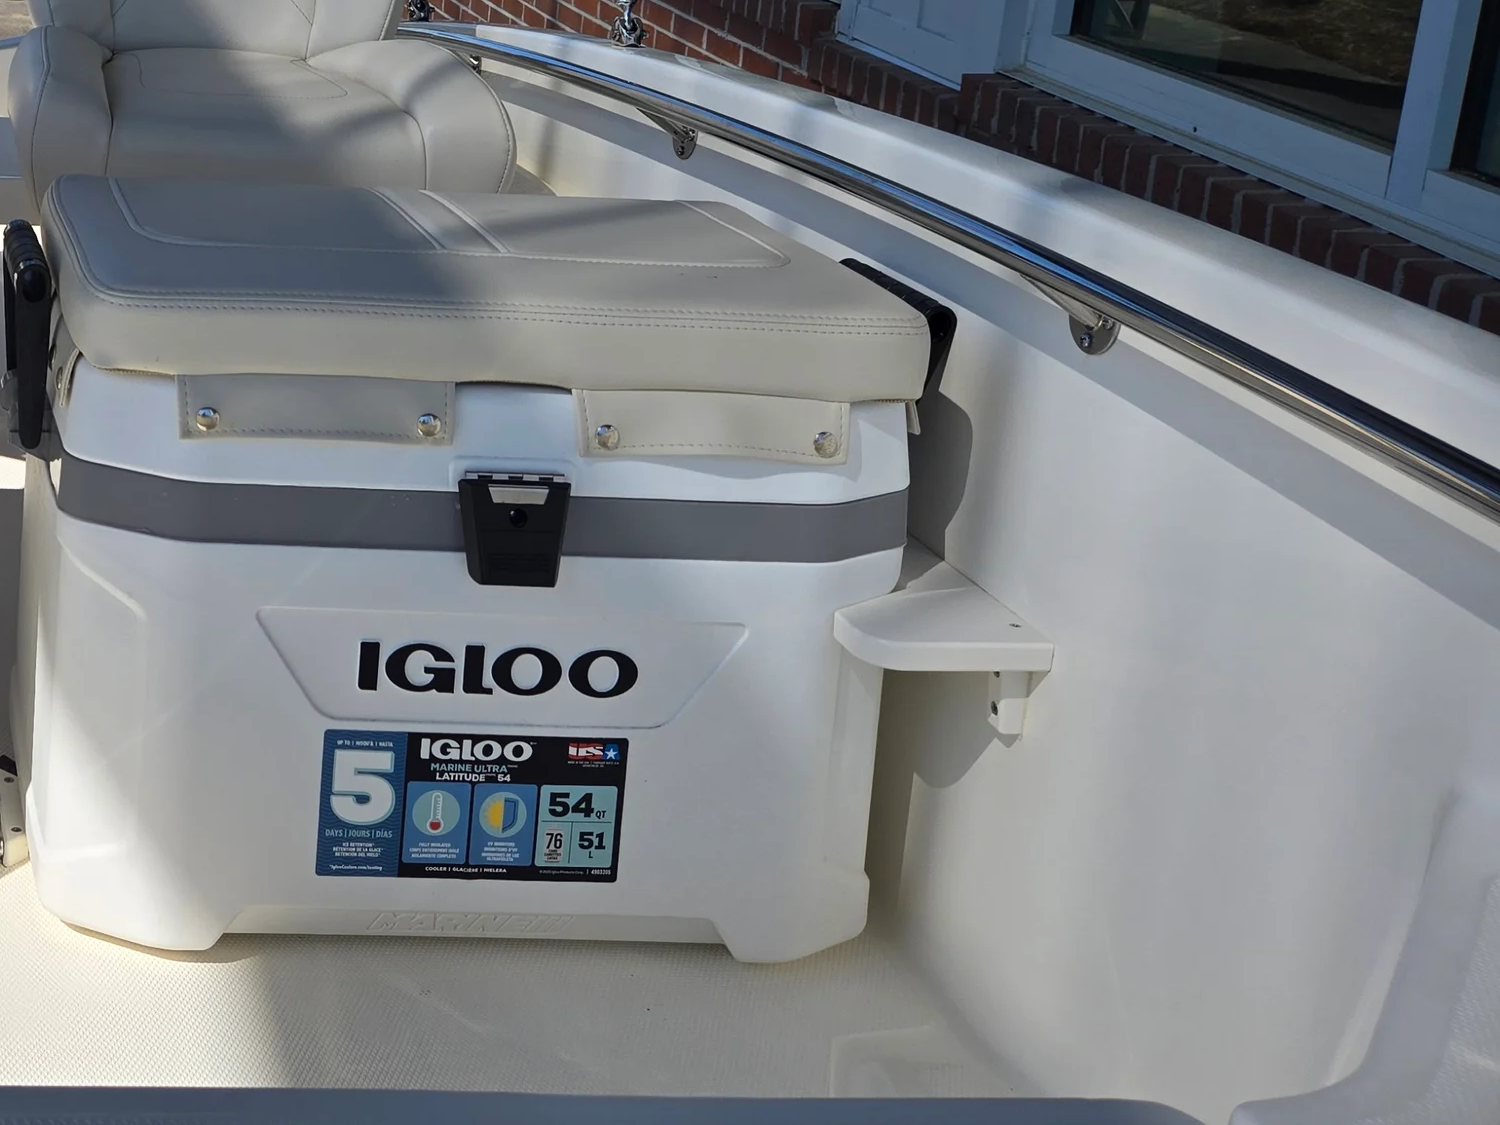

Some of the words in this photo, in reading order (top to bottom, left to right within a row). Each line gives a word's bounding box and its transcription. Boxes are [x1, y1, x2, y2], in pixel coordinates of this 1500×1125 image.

[357, 640, 639, 699] IGLOO
[419, 737, 533, 762] IGLOO
[430, 763, 473, 772] MARINE
[474, 764, 508, 773] ULTRA
[435, 772, 486, 782] LATITUDE
[497, 774, 511, 783] 54
[329, 748, 396, 826] 5
[548, 791, 595, 818] 54
[595, 810, 607, 820] QT
[325, 829, 343, 837] DAYS
[348, 830, 371, 838] JOURS
[376, 828, 393, 838] DÍAS
[545, 832, 563, 850] 76
[578, 831, 606, 850] 51
[588, 850, 594, 859] L
